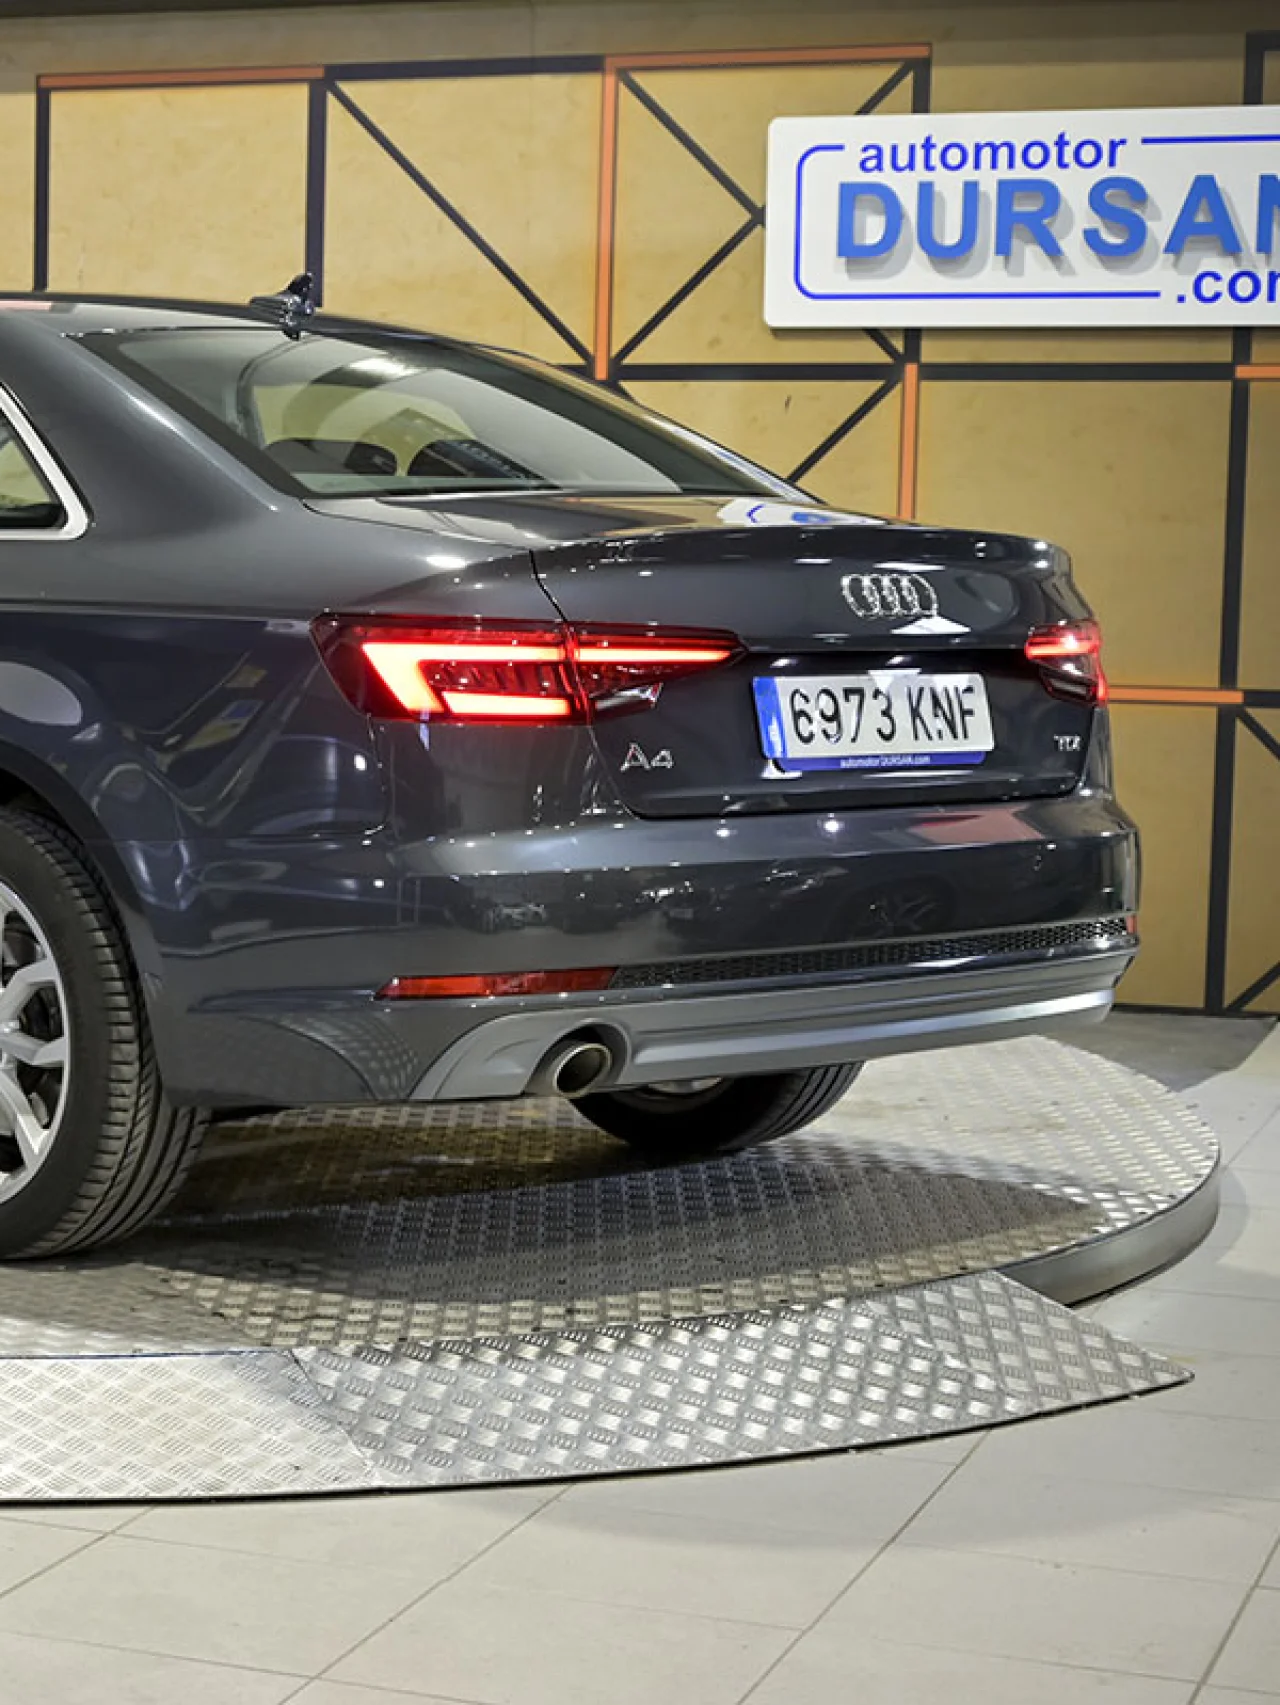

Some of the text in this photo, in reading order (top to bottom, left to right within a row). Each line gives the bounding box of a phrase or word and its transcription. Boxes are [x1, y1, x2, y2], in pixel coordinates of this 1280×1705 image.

[858, 131, 1128, 174] automotor
[1176, 269, 1280, 304] .co
[789, 685, 977, 745] 6973 KNF
[620, 743, 675, 772] A4
